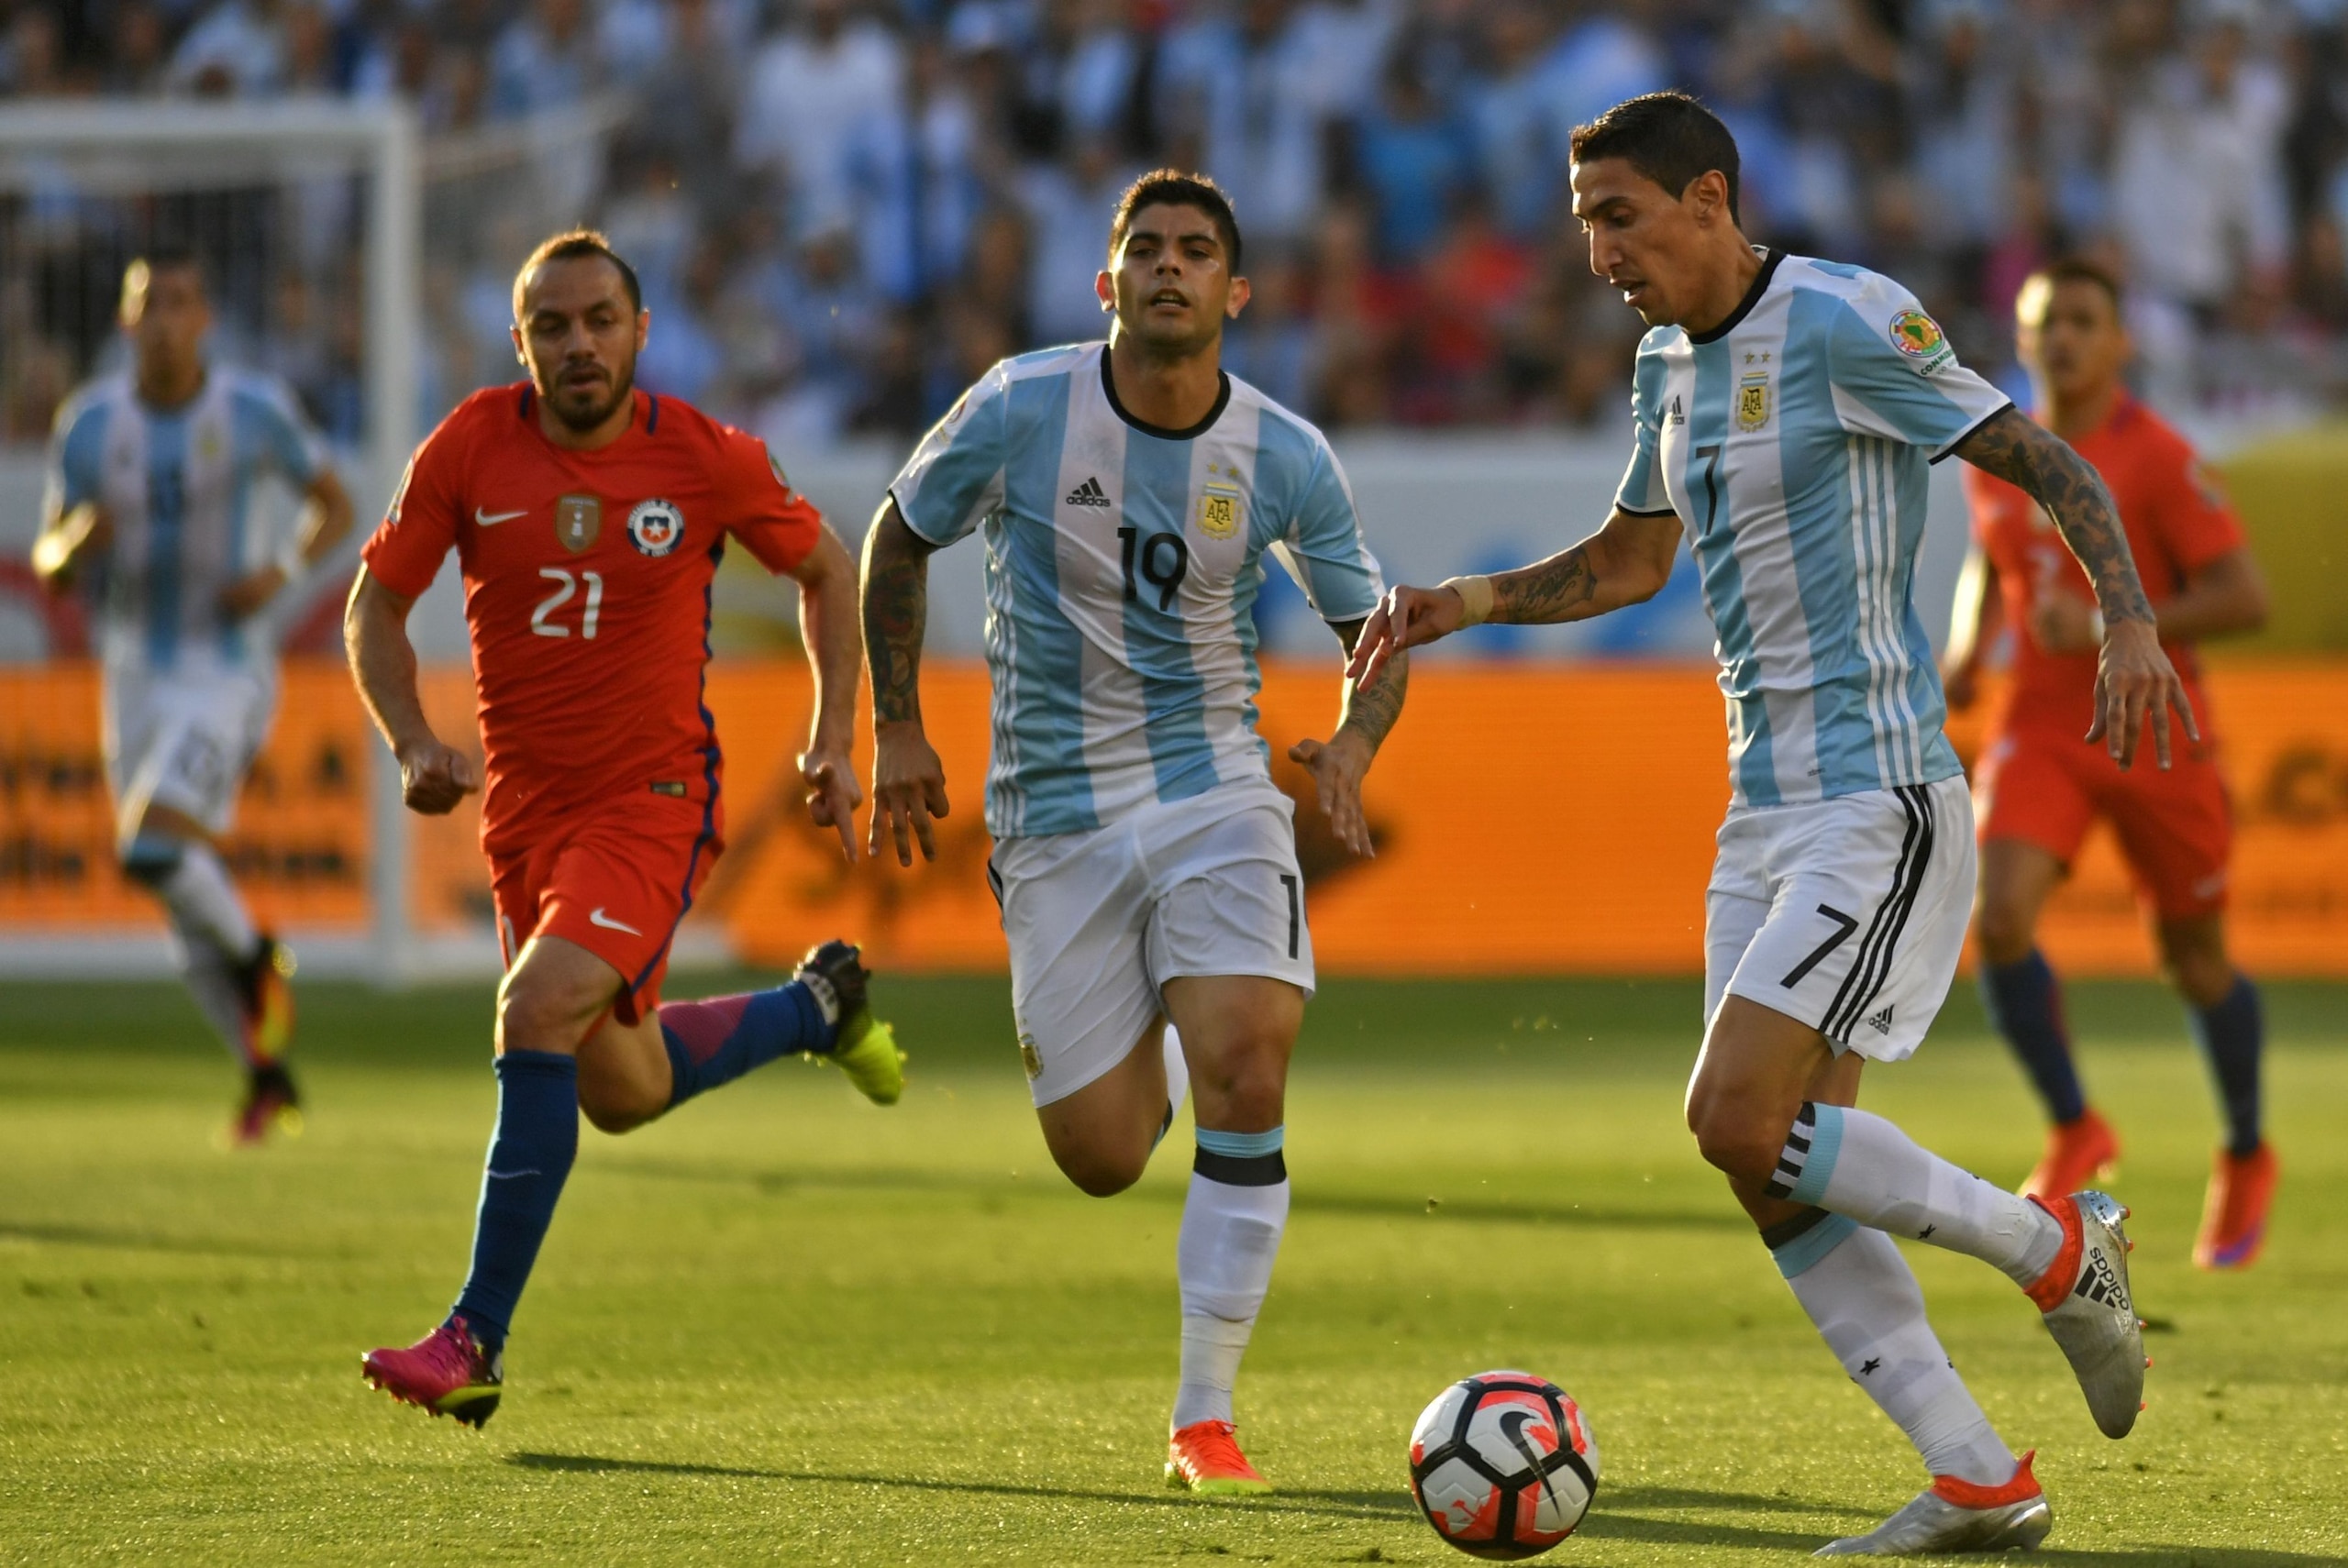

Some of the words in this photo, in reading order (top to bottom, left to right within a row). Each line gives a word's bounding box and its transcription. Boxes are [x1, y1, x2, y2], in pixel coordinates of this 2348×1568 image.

[1920, 348, 1955, 376] CONMEB
[1742, 388, 1762, 415] AFA
[1066, 493, 1111, 507] adidas
[1205, 497, 1232, 525] AFA
[1696, 445, 1721, 536] 7
[1117, 527, 1188, 612] 19
[530, 568, 604, 640] 21
[1279, 874, 1299, 960] 1
[1780, 903, 1859, 988] 7
[2089, 1247, 2130, 1310] adidas
